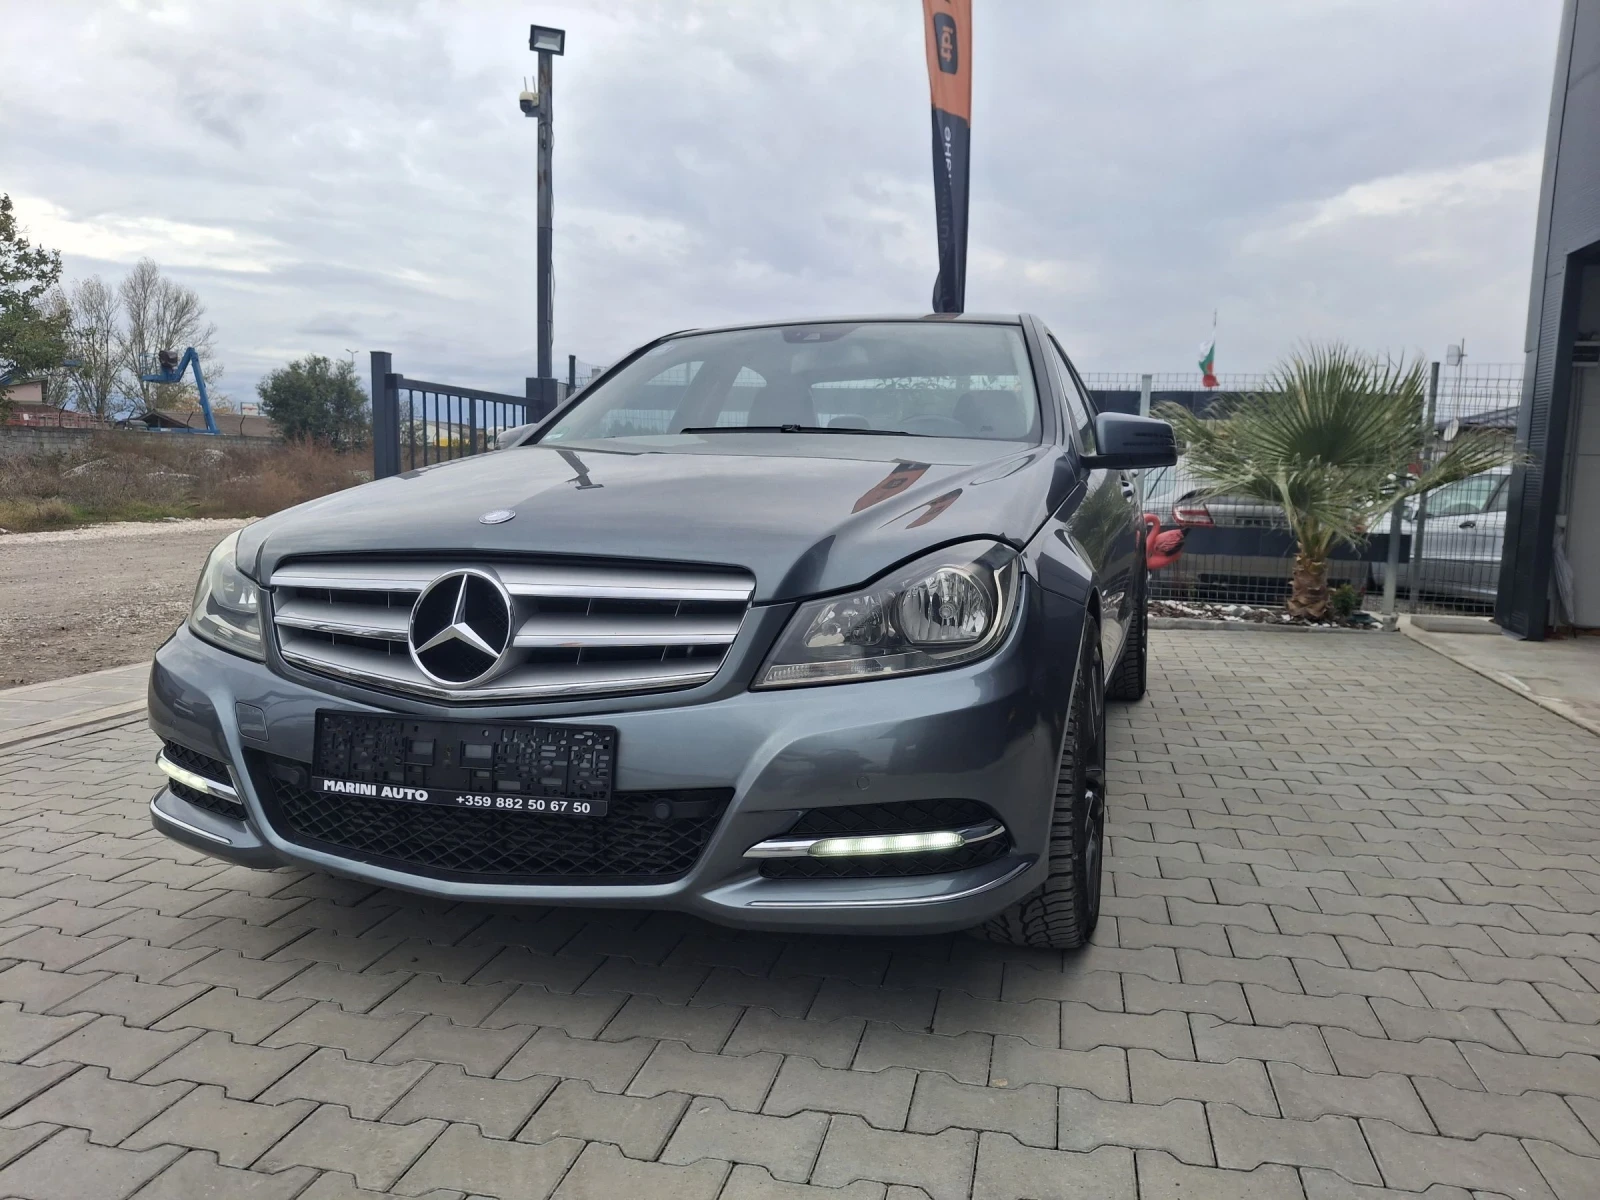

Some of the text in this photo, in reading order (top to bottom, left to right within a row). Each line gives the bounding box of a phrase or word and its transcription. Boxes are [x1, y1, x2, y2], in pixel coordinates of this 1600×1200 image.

[323, 780, 429, 801] MARINI AUTO
[456, 795, 591, 814] +359 882 50 67 50
